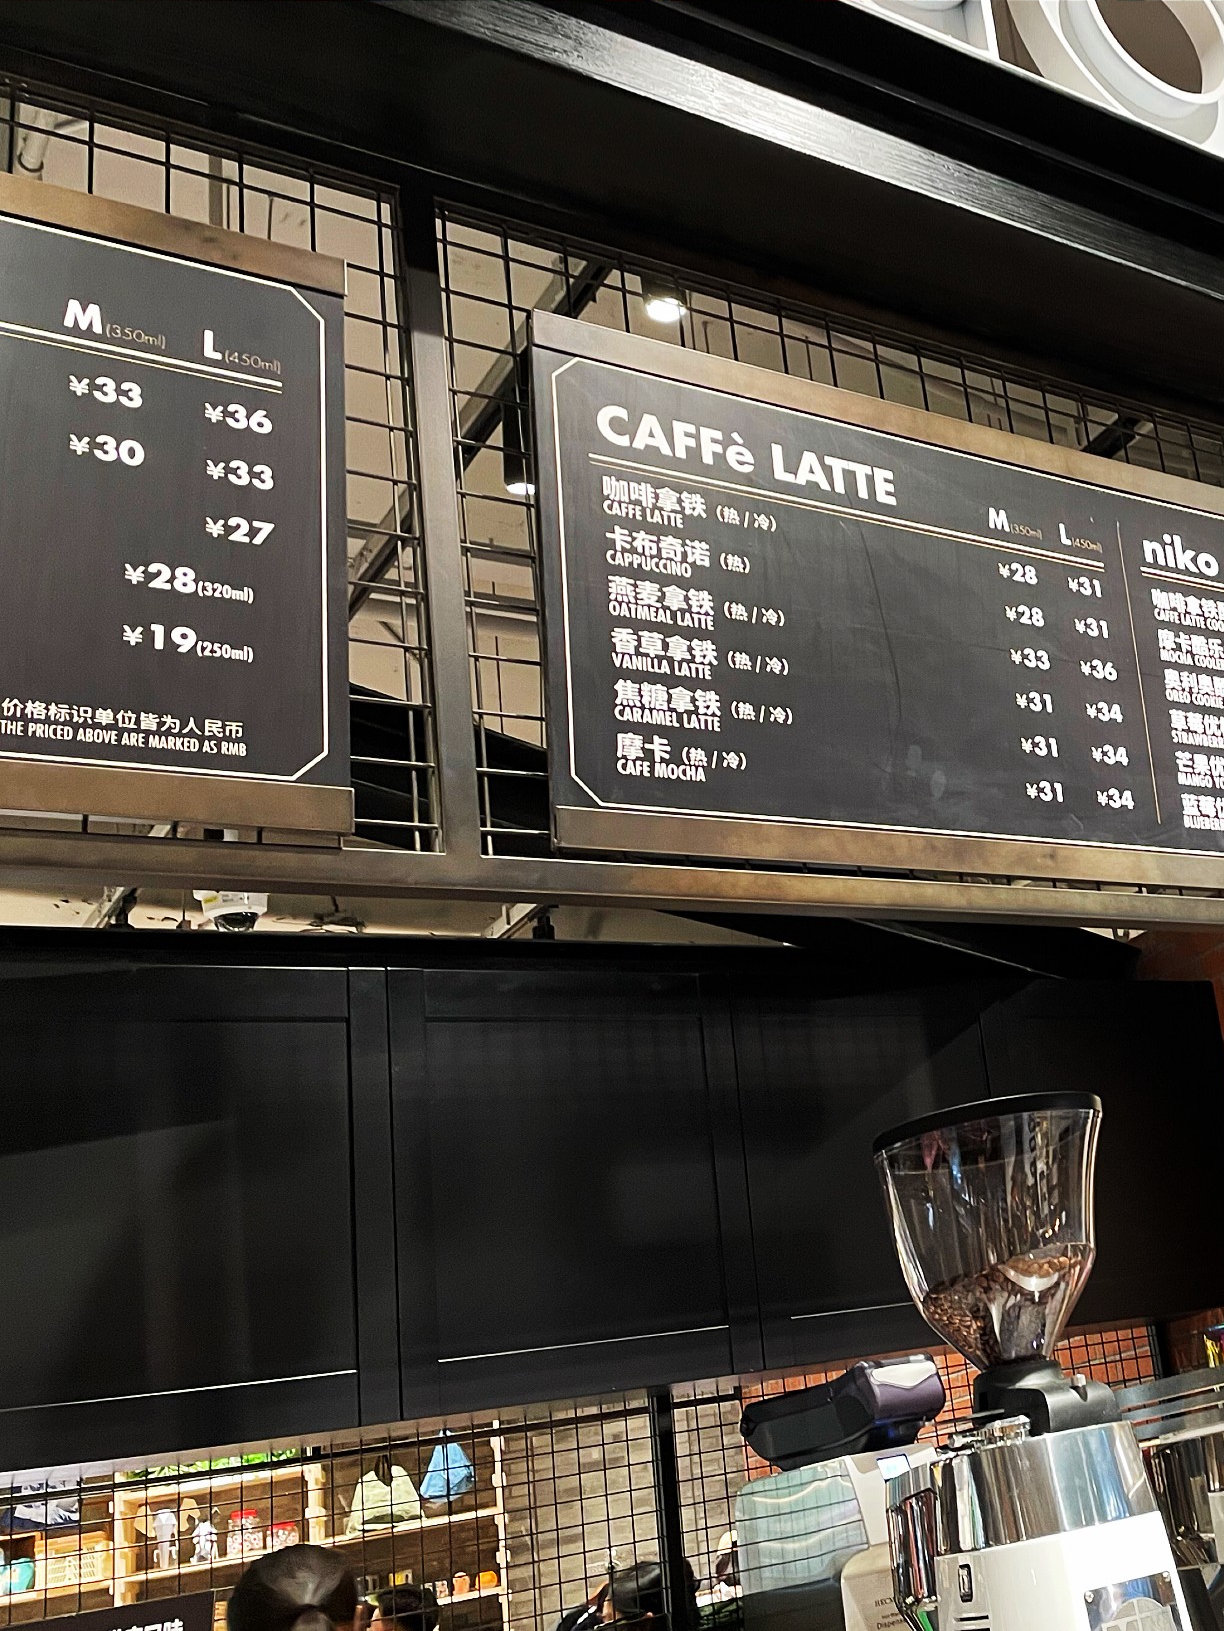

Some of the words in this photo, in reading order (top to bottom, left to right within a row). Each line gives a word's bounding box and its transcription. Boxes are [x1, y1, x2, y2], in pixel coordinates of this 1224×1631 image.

[69, 374, 143, 408] ¥33
[204, 402, 273, 434] ¥36
[69, 433, 145, 467] ¥30
[596, 405, 755, 473] CAFFè
[770, 442, 897, 506] LATTE
[206, 459, 274, 491] ¥33
[602, 475, 707, 519] 咖啡拿铁
[602, 502, 642, 521] CAFFE
[646, 509, 684, 529] LATTE
[205, 516, 275, 545] ¥27
[605, 524, 710, 568] 卡布奇诺
[719, 551, 750, 574] (热)
[1142, 533, 1219, 577] niko
[605, 549, 692, 578] CAPPUCCINO
[998, 562, 1038, 585] ¥28
[607, 574, 715, 617] 燕麦拿铁
[1068, 576, 1102, 598] ¥31
[608, 600, 673, 625] OATMEAL
[676, 612, 715, 631] LATTE
[1005, 605, 1045, 627] ¥28
[1075, 617, 1109, 639] ¥31
[611, 627, 718, 666] 香草拿铁
[1010, 647, 1051, 671] ¥33
[1160, 648, 1194, 666] MOCHA
[611, 652, 671, 675] VANILLA
[673, 660, 712, 680] LATTE
[1080, 659, 1118, 681] ¥36
[614, 678, 721, 717] 焦糖拿铁
[1015, 691, 1053, 713] ¥31
[1165, 689, 1191, 704] OREO
[1192, 693, 1224, 708] COOKIE
[1, 697, 244, 739] 价格标识单位皆为人民币
[613, 705, 680, 729] CARAMEL
[683, 713, 721, 732] LATTE
[1086, 701, 1124, 723] ¥34
[0, 722, 24, 736] THE
[27, 723, 73, 741] PRICED
[76, 728, 118, 745] ABOVE
[121, 732, 145, 748] ARE
[148, 735, 199, 753] MARKED
[203, 740, 217, 754] AS
[221, 741, 247, 757] RMB
[615, 732, 671, 763] 摩卡
[1021, 735, 1059, 758] ¥31
[1091, 744, 1129, 766] ¥34
[616, 759, 651, 777] CAFE
[654, 762, 706, 782] MOCHA
[1178, 772, 1212, 788] MANGO
[1026, 780, 1064, 803] ¥31
[1096, 787, 1135, 810] ¥34
